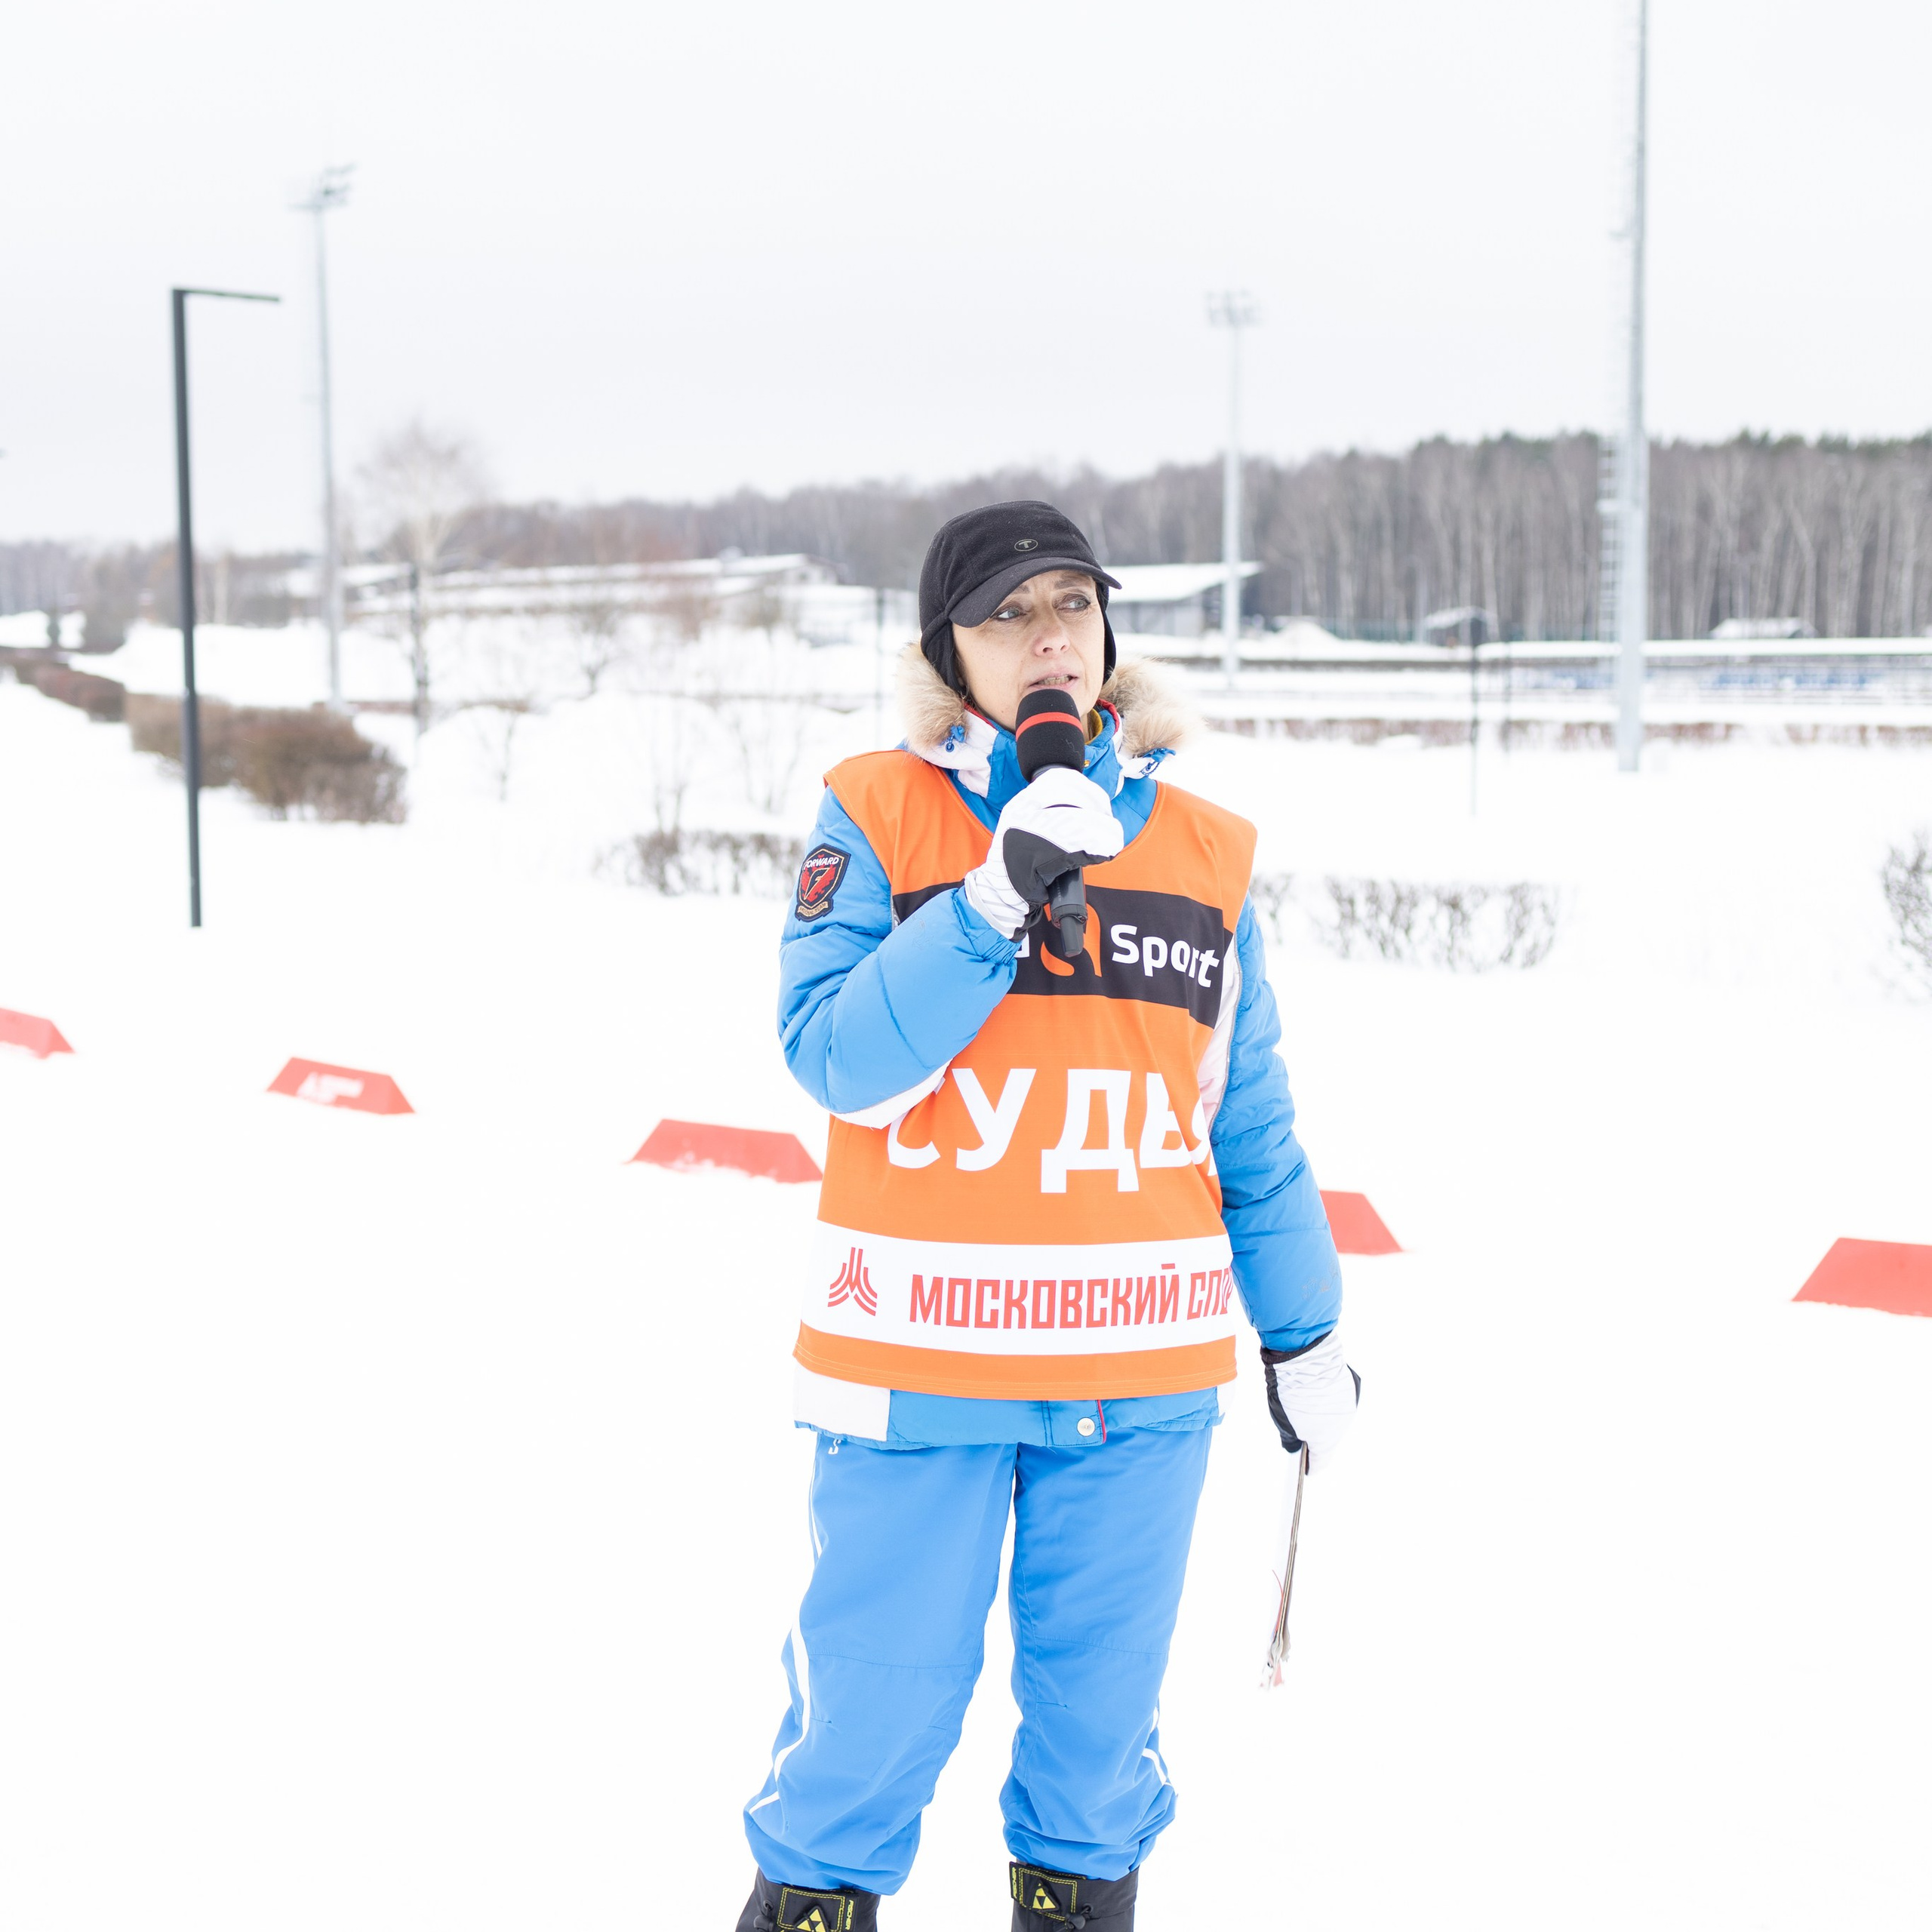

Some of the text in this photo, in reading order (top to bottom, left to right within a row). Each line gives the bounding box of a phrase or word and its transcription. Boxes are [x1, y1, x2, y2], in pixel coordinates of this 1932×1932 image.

[803, 857, 840, 870] FORWARD
[1110, 924, 1220, 988] Sport
[909, 1263, 1180, 1329] МОСКОВСКИЙ
[845, 1899, 854, 1930] FISCHER
